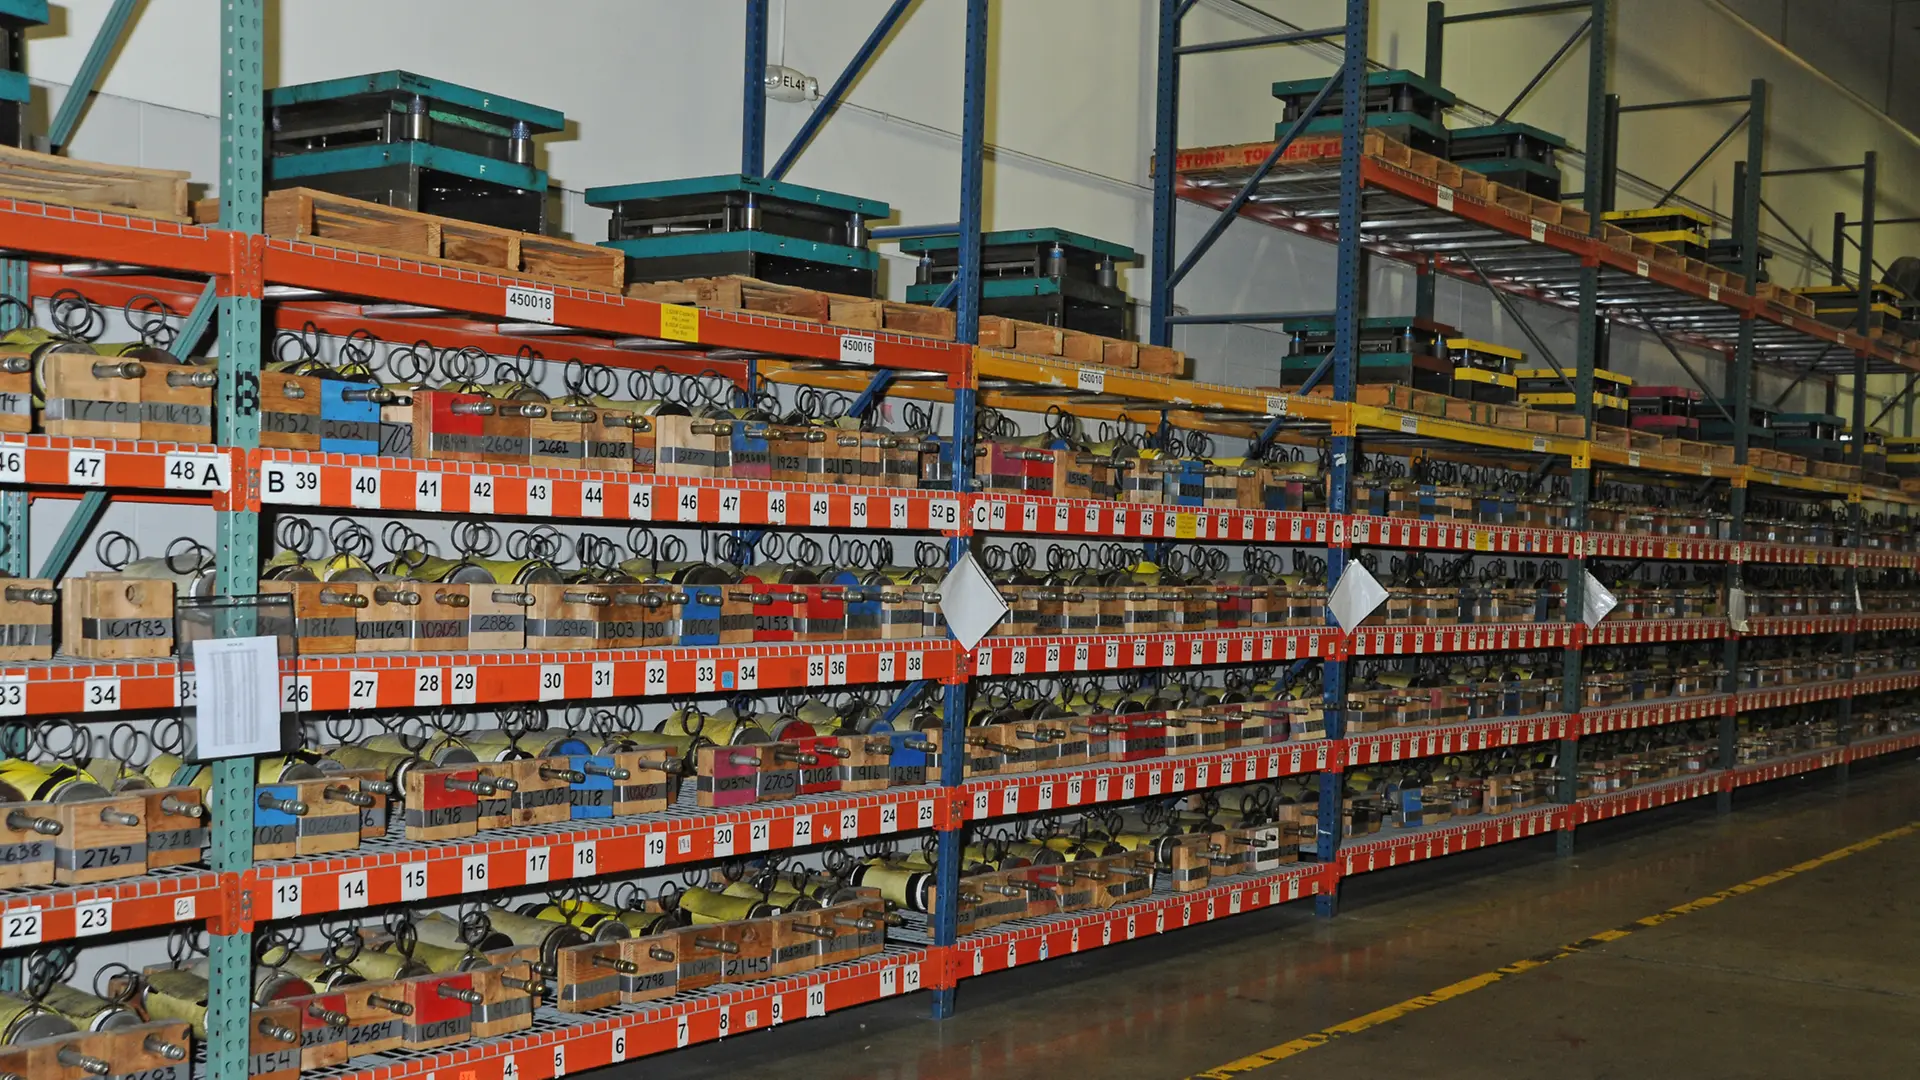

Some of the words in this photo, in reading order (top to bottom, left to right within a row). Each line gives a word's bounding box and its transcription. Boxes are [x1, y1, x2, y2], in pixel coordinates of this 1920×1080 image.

[783, 75, 805, 91] EL48
[484, 99, 489, 107] F
[480, 165, 486, 174] F
[509, 292, 552, 310] 450018
[842, 340, 873, 353] 450016
[1079, 372, 1103, 385] 450010
[71, 400, 128, 423] 1779
[267, 413, 313, 435] 1852
[326, 421, 370, 440] 2021
[485, 435, 523, 454] 2604
[594, 442, 625, 458] 1028
[74, 458, 101, 477] 47
[777, 456, 800, 469] 1923
[826, 460, 853, 474] 2115
[171, 461, 195, 481] 48
[202, 463, 222, 487] A
[268, 470, 286, 493] B
[296, 471, 317, 490] 39
[355, 476, 377, 495] 40
[419, 483, 437, 497] 41
[474, 482, 491, 497] 42
[530, 485, 546, 500] 43
[585, 488, 602, 503] 44
[633, 492, 650, 508] 45
[681, 495, 697, 510] 46
[723, 496, 738, 511] 47
[771, 499, 785, 513] 48
[814, 501, 827, 515] 49
[853, 502, 866, 516] 50
[894, 504, 906, 517] 51
[931, 505, 943, 518] 52
[947, 507, 955, 523] B
[977, 506, 986, 522] C
[993, 506, 1004, 518] 40
[1025, 508, 1036, 521] 41
[1057, 507, 1067, 520] 42
[1087, 508, 1096, 520] 43
[1115, 511, 1125, 523] 44
[1143, 513, 1152, 525] 45
[1166, 515, 1175, 527] 46
[1197, 516, 1205, 528] 47
[1219, 518, 1228, 528] 48
[1245, 519, 1253, 530] 49
[1267, 520, 1275, 531] 50
[1293, 521, 1300, 531] 51
[1318, 522, 1325, 534] 52
[1335, 525, 1340, 536] C
[1354, 526, 1359, 537] D
[1362, 524, 1368, 534] 39
[479, 616, 516, 631] 2886
[555, 621, 588, 637] 2896
[603, 621, 635, 639] 1303
[756, 616, 789, 630] 2153
[1244, 640, 1252, 652] 36
[1264, 639, 1272, 651] 37
[1288, 639, 1295, 651] 38
[1311, 637, 1318, 648] 39
[1358, 635, 1365, 646] 26
[1376, 635, 1384, 646] 27
[1077, 648, 1087, 661] 30
[1107, 646, 1117, 658] 31
[1136, 644, 1145, 657] 32
[1165, 645, 1174, 657] 33
[1193, 644, 1201, 655] 34
[1218, 643, 1227, 654] 35
[980, 652, 990, 666] 27
[1014, 651, 1024, 664] 28
[1048, 650, 1058, 662] 29
[809, 662, 824, 676] 35
[831, 661, 844, 675] 36
[881, 659, 892, 672] 37
[909, 657, 921, 671] 38
[594, 669, 611, 686] 31
[649, 669, 665, 684] 32
[698, 666, 713, 681] 33
[741, 665, 756, 680] 34
[420, 675, 438, 691] 28
[455, 673, 474, 690] 29
[544, 672, 561, 688] 30
[90, 686, 116, 704] 34
[287, 684, 308, 703] 26
[353, 680, 374, 697] 27
[1318, 750, 1326, 761] 26
[1351, 746, 1357, 756] 13
[1372, 745, 1378, 754] 14
[1270, 758, 1278, 770] 24
[1293, 753, 1300, 764] 25
[1198, 766, 1206, 778] 21
[1223, 762, 1231, 773] 22
[1247, 760, 1255, 772] 23
[764, 773, 795, 791] 2705
[1098, 779, 1107, 791] 17
[1125, 778, 1134, 789] 18
[1152, 774, 1160, 785] 19
[1175, 773, 1184, 784] 20
[1042, 787, 1051, 799] 15
[1070, 782, 1080, 794] 16
[570, 789, 603, 807] 2118
[976, 796, 987, 809] 13
[1006, 792, 1017, 803] 14
[883, 810, 895, 823] 24
[920, 806, 932, 819] 25
[796, 821, 810, 835] 22
[843, 815, 856, 829] 23
[717, 830, 732, 844] 20
[753, 825, 766, 839] 21
[649, 838, 664, 855] 19
[82, 846, 132, 869] 2767
[530, 856, 547, 871] 17
[578, 850, 594, 865] 18
[405, 871, 425, 887] 15
[467, 864, 485, 880] 16
[344, 880, 364, 898] 14
[1272, 884, 1279, 895] 11
[1291, 880, 1298, 890] 12
[277, 885, 298, 903] 13
[1232, 894, 1240, 904] 10
[1184, 908, 1188, 919] 8
[1208, 903, 1212, 914] 9
[9, 917, 37, 938] 22
[81, 914, 108, 929] 23
[1128, 921, 1134, 932] 6
[1158, 916, 1163, 926] 7
[1104, 926, 1109, 936] 5
[1072, 933, 1078, 944] 4
[976, 951, 981, 963] 1
[1010, 945, 1015, 956] 2
[727, 957, 768, 976] 2145
[636, 974, 664, 992] 2798
[882, 971, 894, 985] 11
[906, 969, 918, 984] 12
[810, 991, 823, 1006] 10
[772, 1004, 780, 1018] 9
[720, 1014, 728, 1030] 8
[679, 1023, 686, 1040] 7
[615, 1038, 625, 1053] 6
[555, 1053, 562, 1067] 5
[505, 1063, 512, 1076] 4
